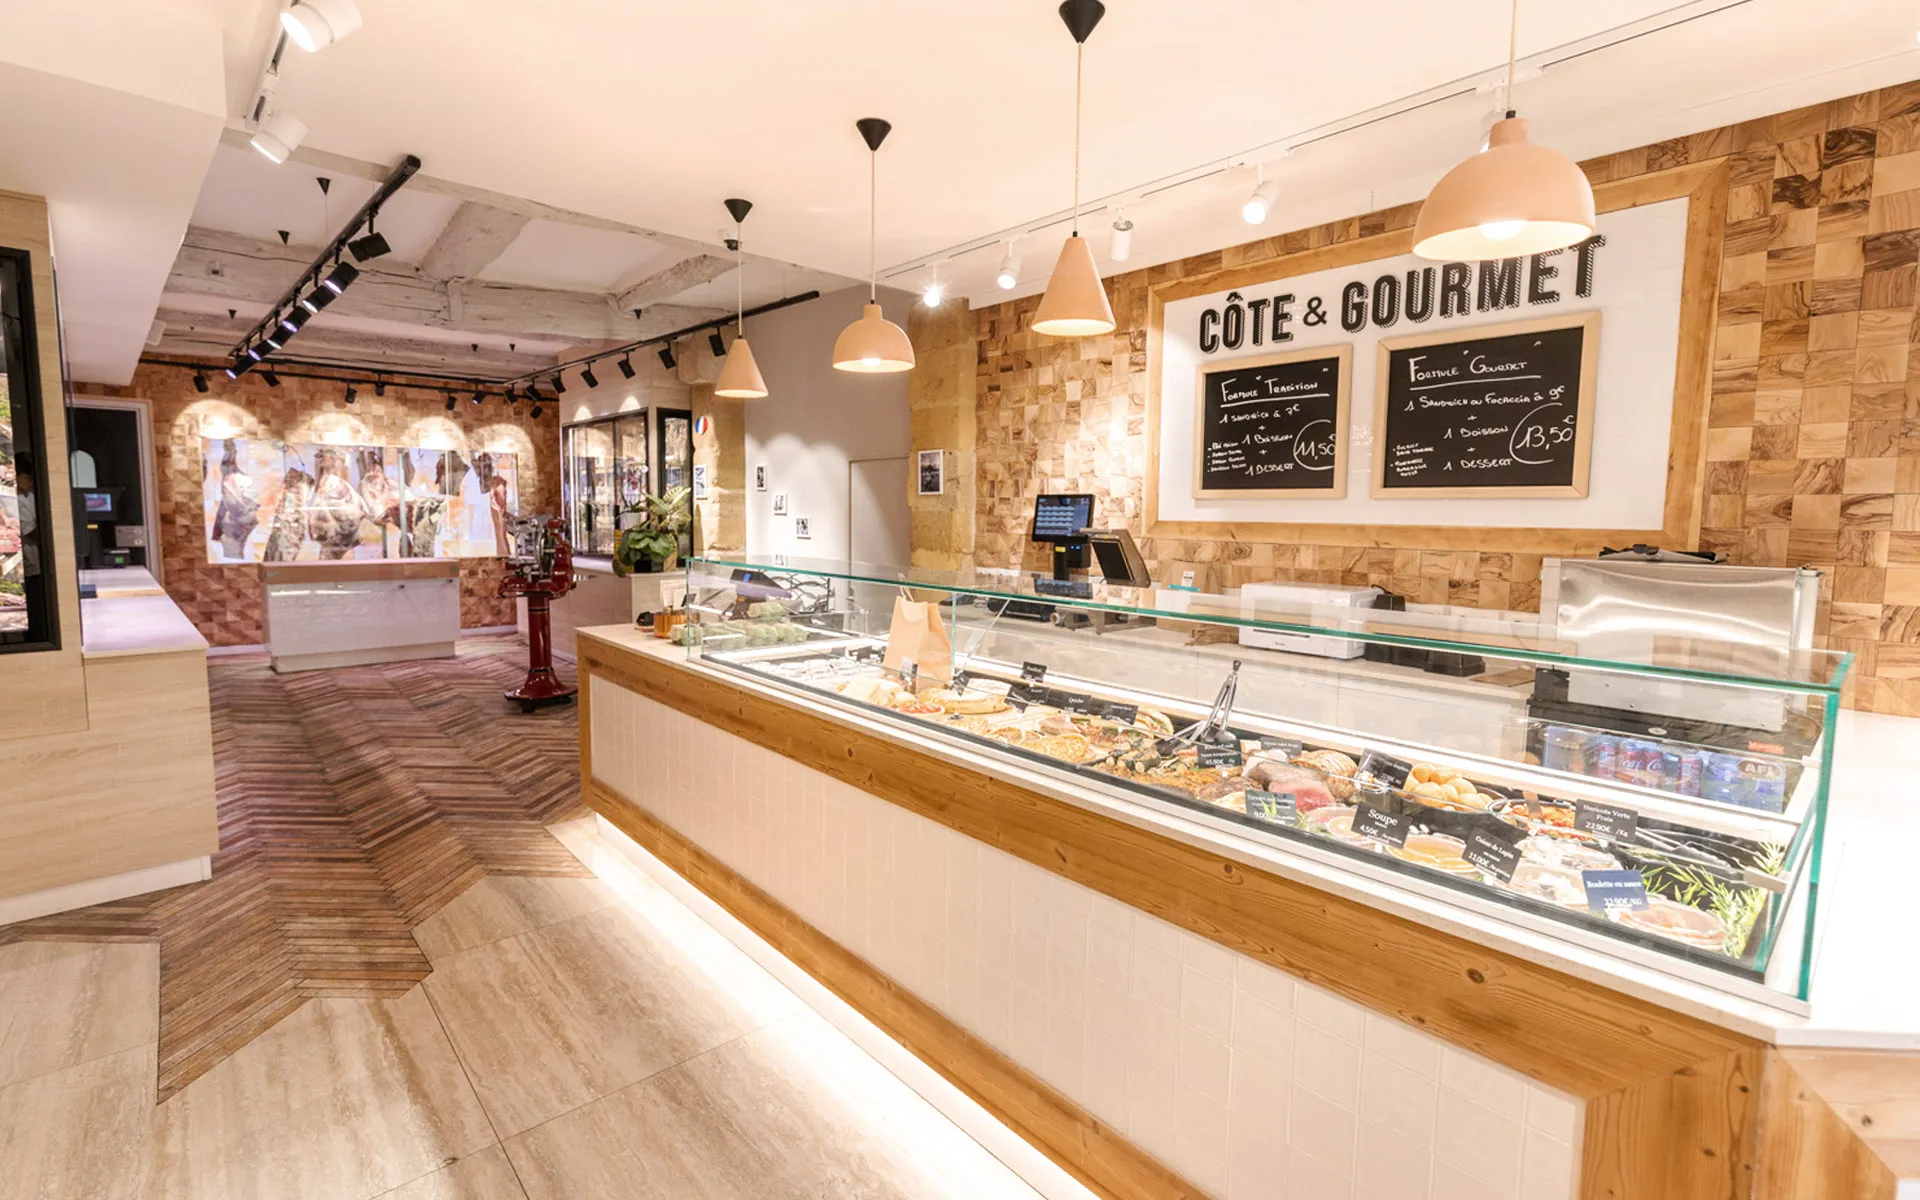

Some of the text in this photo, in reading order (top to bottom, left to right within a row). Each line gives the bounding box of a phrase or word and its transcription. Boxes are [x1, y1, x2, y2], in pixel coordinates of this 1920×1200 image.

[1200, 234, 1606, 354] CÔTE & GOURMET
[1404, 401, 1415, 412] 1
[1443, 427, 1453, 439] 1
[1443, 461, 1453, 471] 1
[1368, 808, 1398, 827] Soupe
